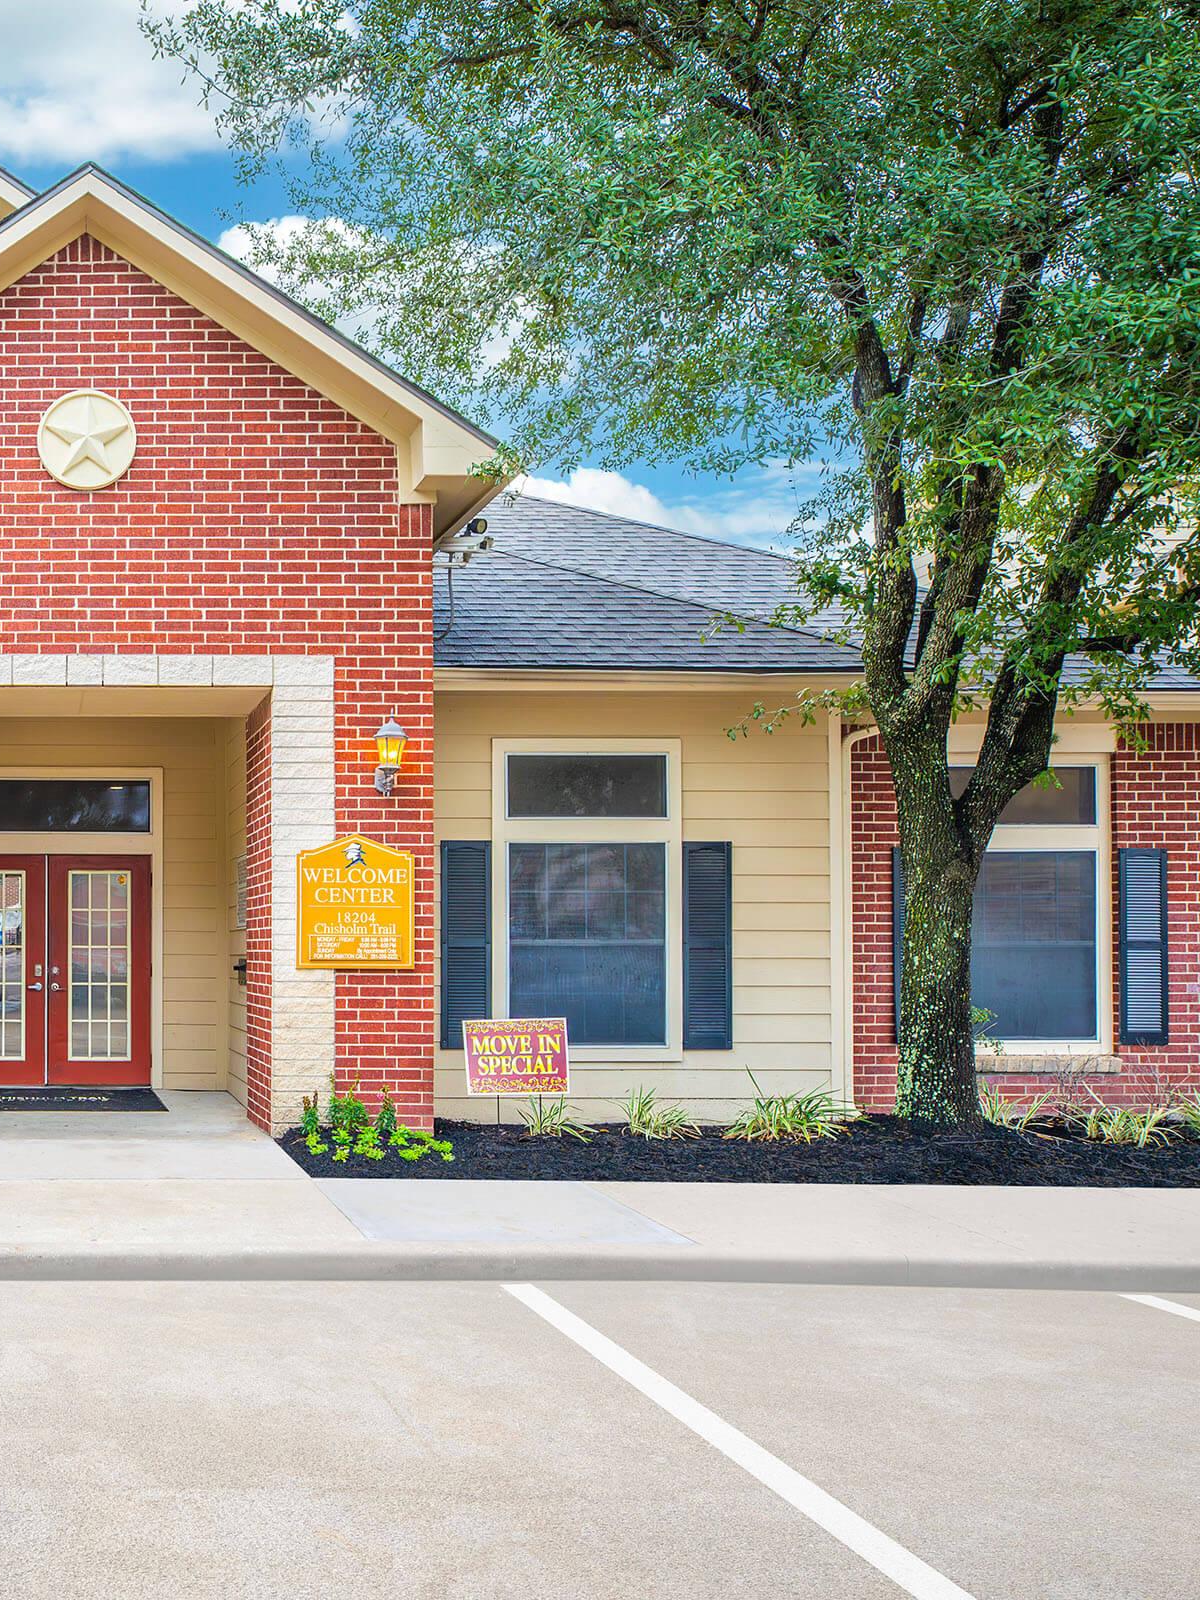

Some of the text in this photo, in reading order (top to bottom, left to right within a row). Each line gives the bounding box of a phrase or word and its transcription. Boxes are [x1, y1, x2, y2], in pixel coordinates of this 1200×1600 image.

[303, 868, 408, 884] WELCOME
[315, 888, 395, 903] CENTER
[337, 912, 376, 923] 18204
[314, 923, 397, 935] Chisholm Trail
[471, 1034, 561, 1056] MOVE IN
[478, 1055, 558, 1076] SPECIAL
